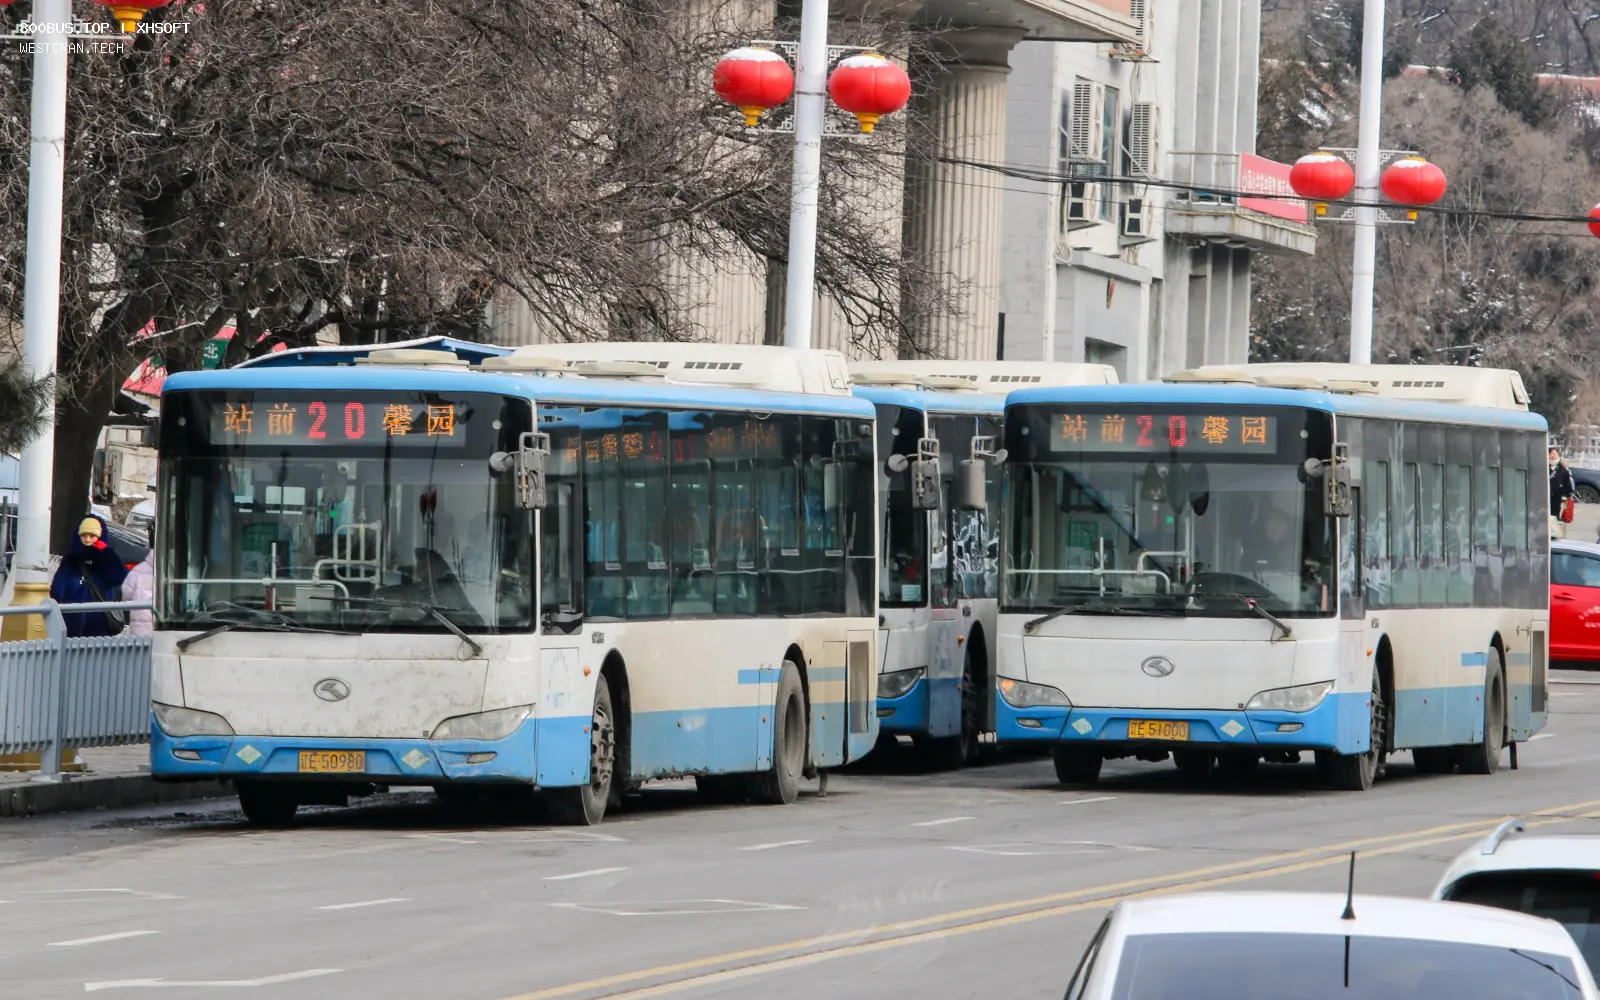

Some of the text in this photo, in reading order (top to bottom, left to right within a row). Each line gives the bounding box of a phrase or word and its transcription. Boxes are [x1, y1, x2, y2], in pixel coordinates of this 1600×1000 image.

[222, 400, 455, 440] 站前 20 馨园
[1060, 414, 1267, 447] 站前 20 馨园
